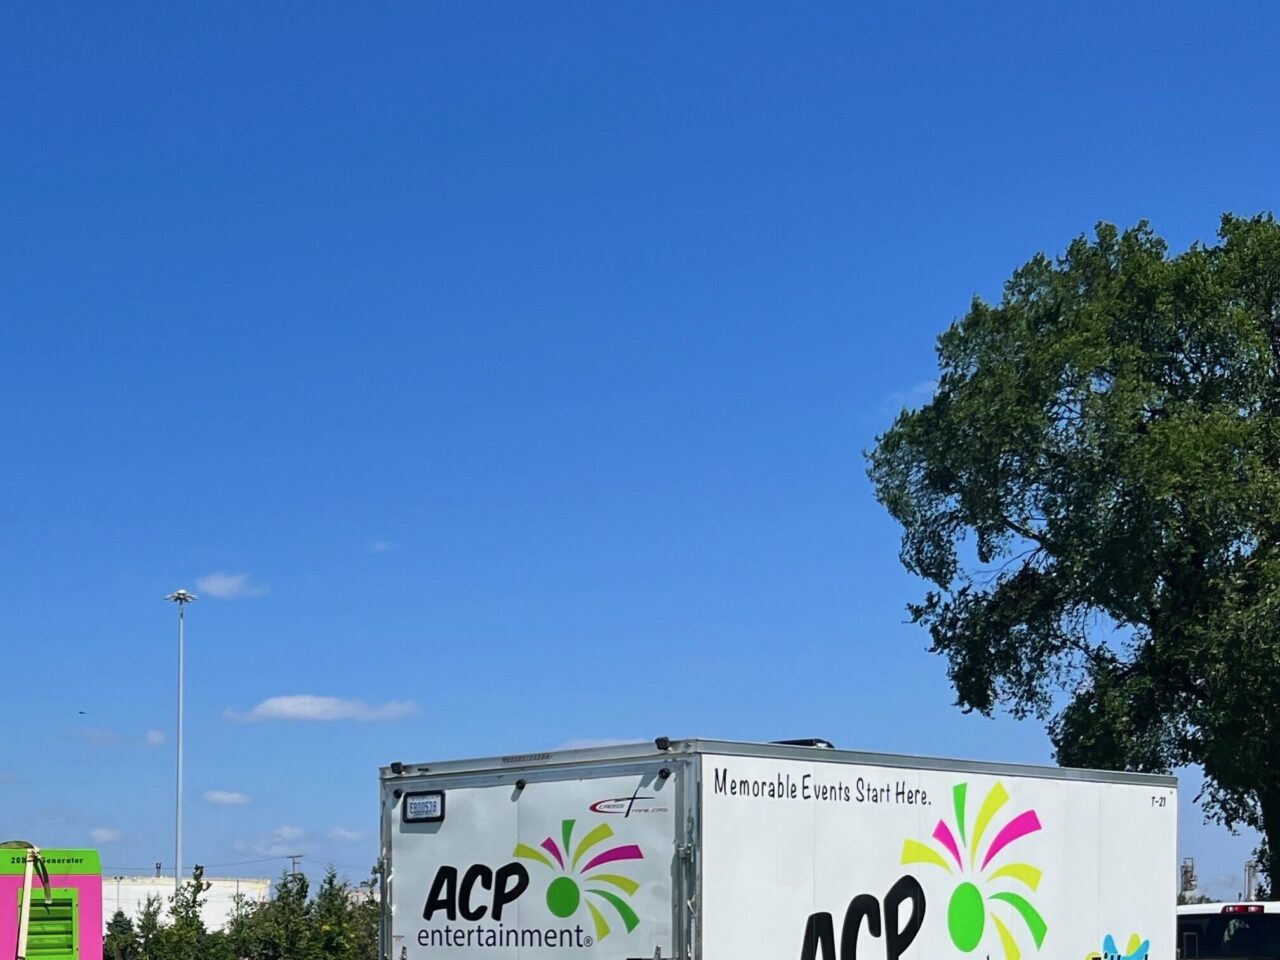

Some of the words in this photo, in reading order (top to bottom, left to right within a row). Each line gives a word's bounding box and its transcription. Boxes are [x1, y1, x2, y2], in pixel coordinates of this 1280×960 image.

[714, 768, 797, 798] Memorable
[802, 773, 851, 801] Events
[856, 777, 890, 803] Start
[895, 781, 932, 806] Here.
[422, 862, 529, 921] ACP
